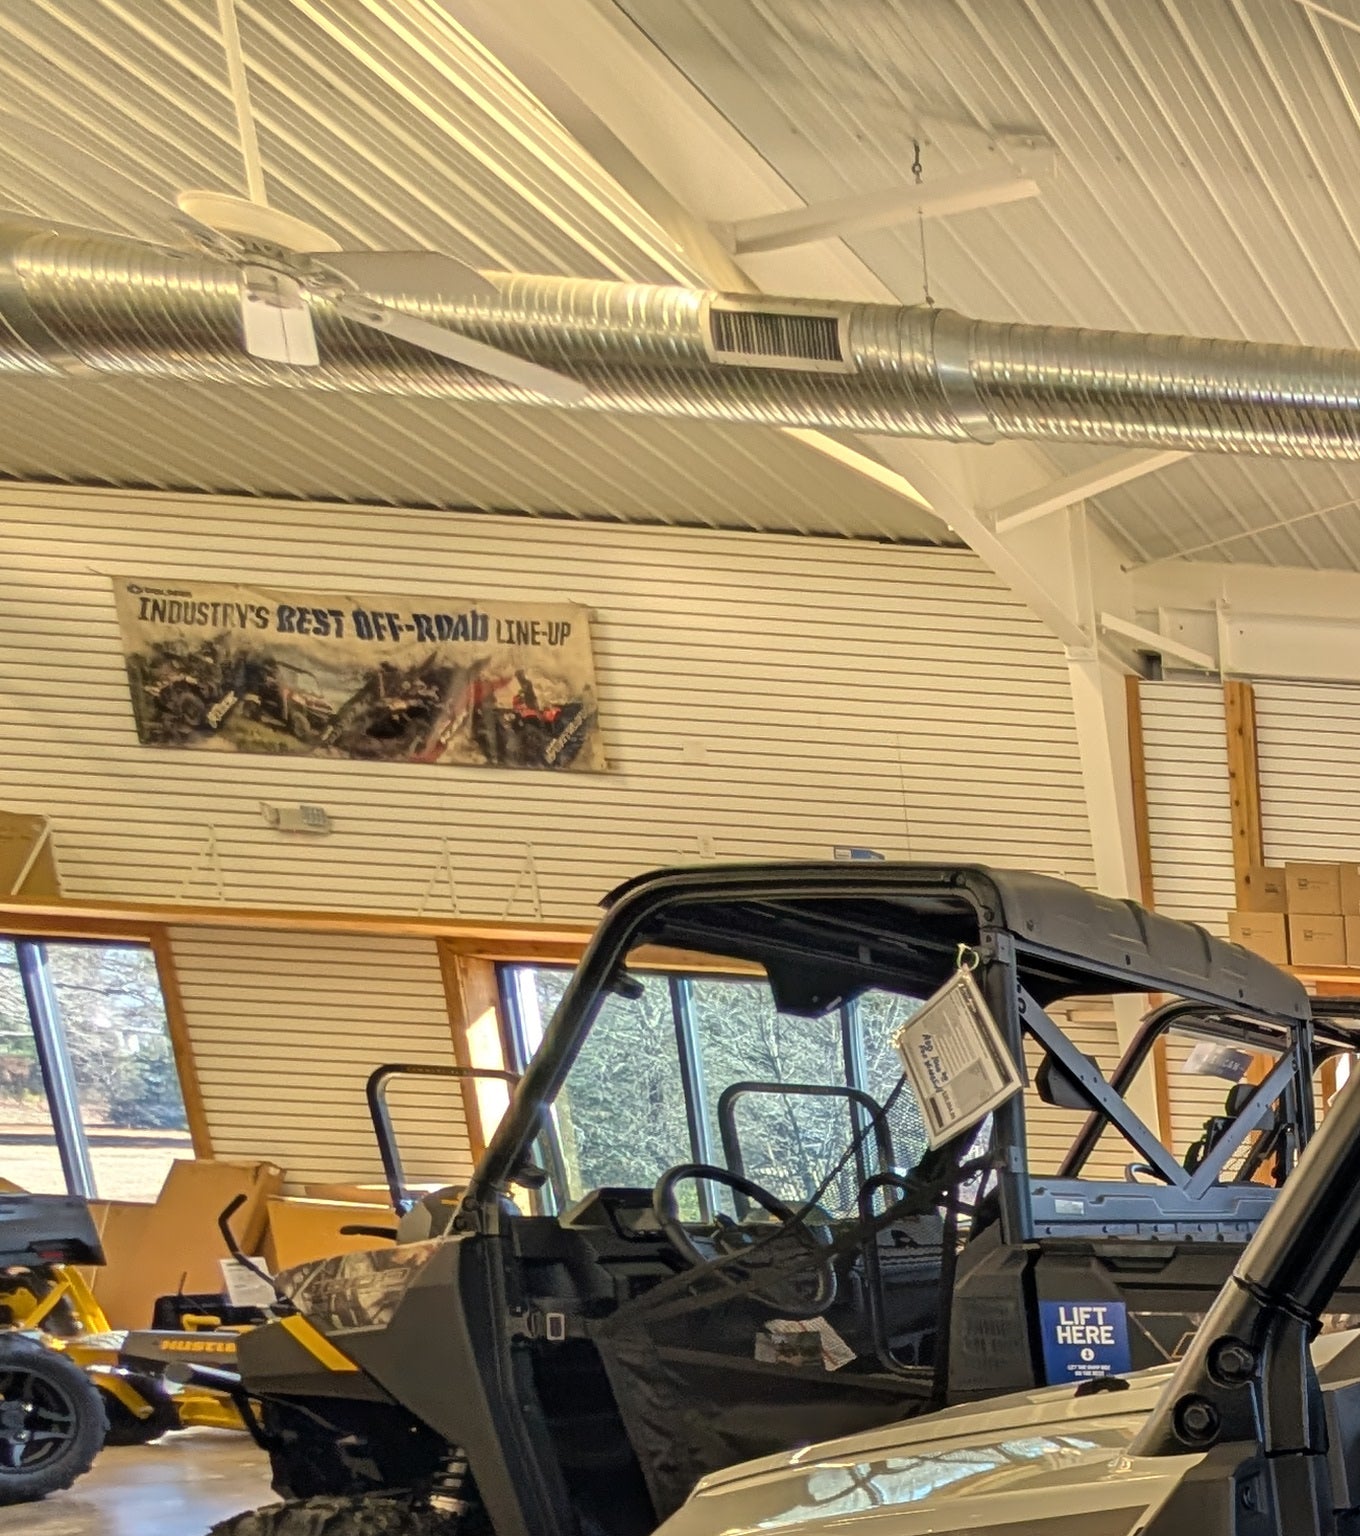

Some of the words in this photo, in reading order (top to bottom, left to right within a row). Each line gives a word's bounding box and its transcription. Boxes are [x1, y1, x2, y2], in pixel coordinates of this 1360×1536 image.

[138, 597, 270, 629] INDUSTRY'S
[277, 604, 344, 638] BEST
[352, 610, 489, 642] OFF-ROAD
[496, 619, 571, 646] LINE-UP
[1059, 1306, 1107, 1325] LIFT
[1056, 1326, 1115, 1344] HERE
